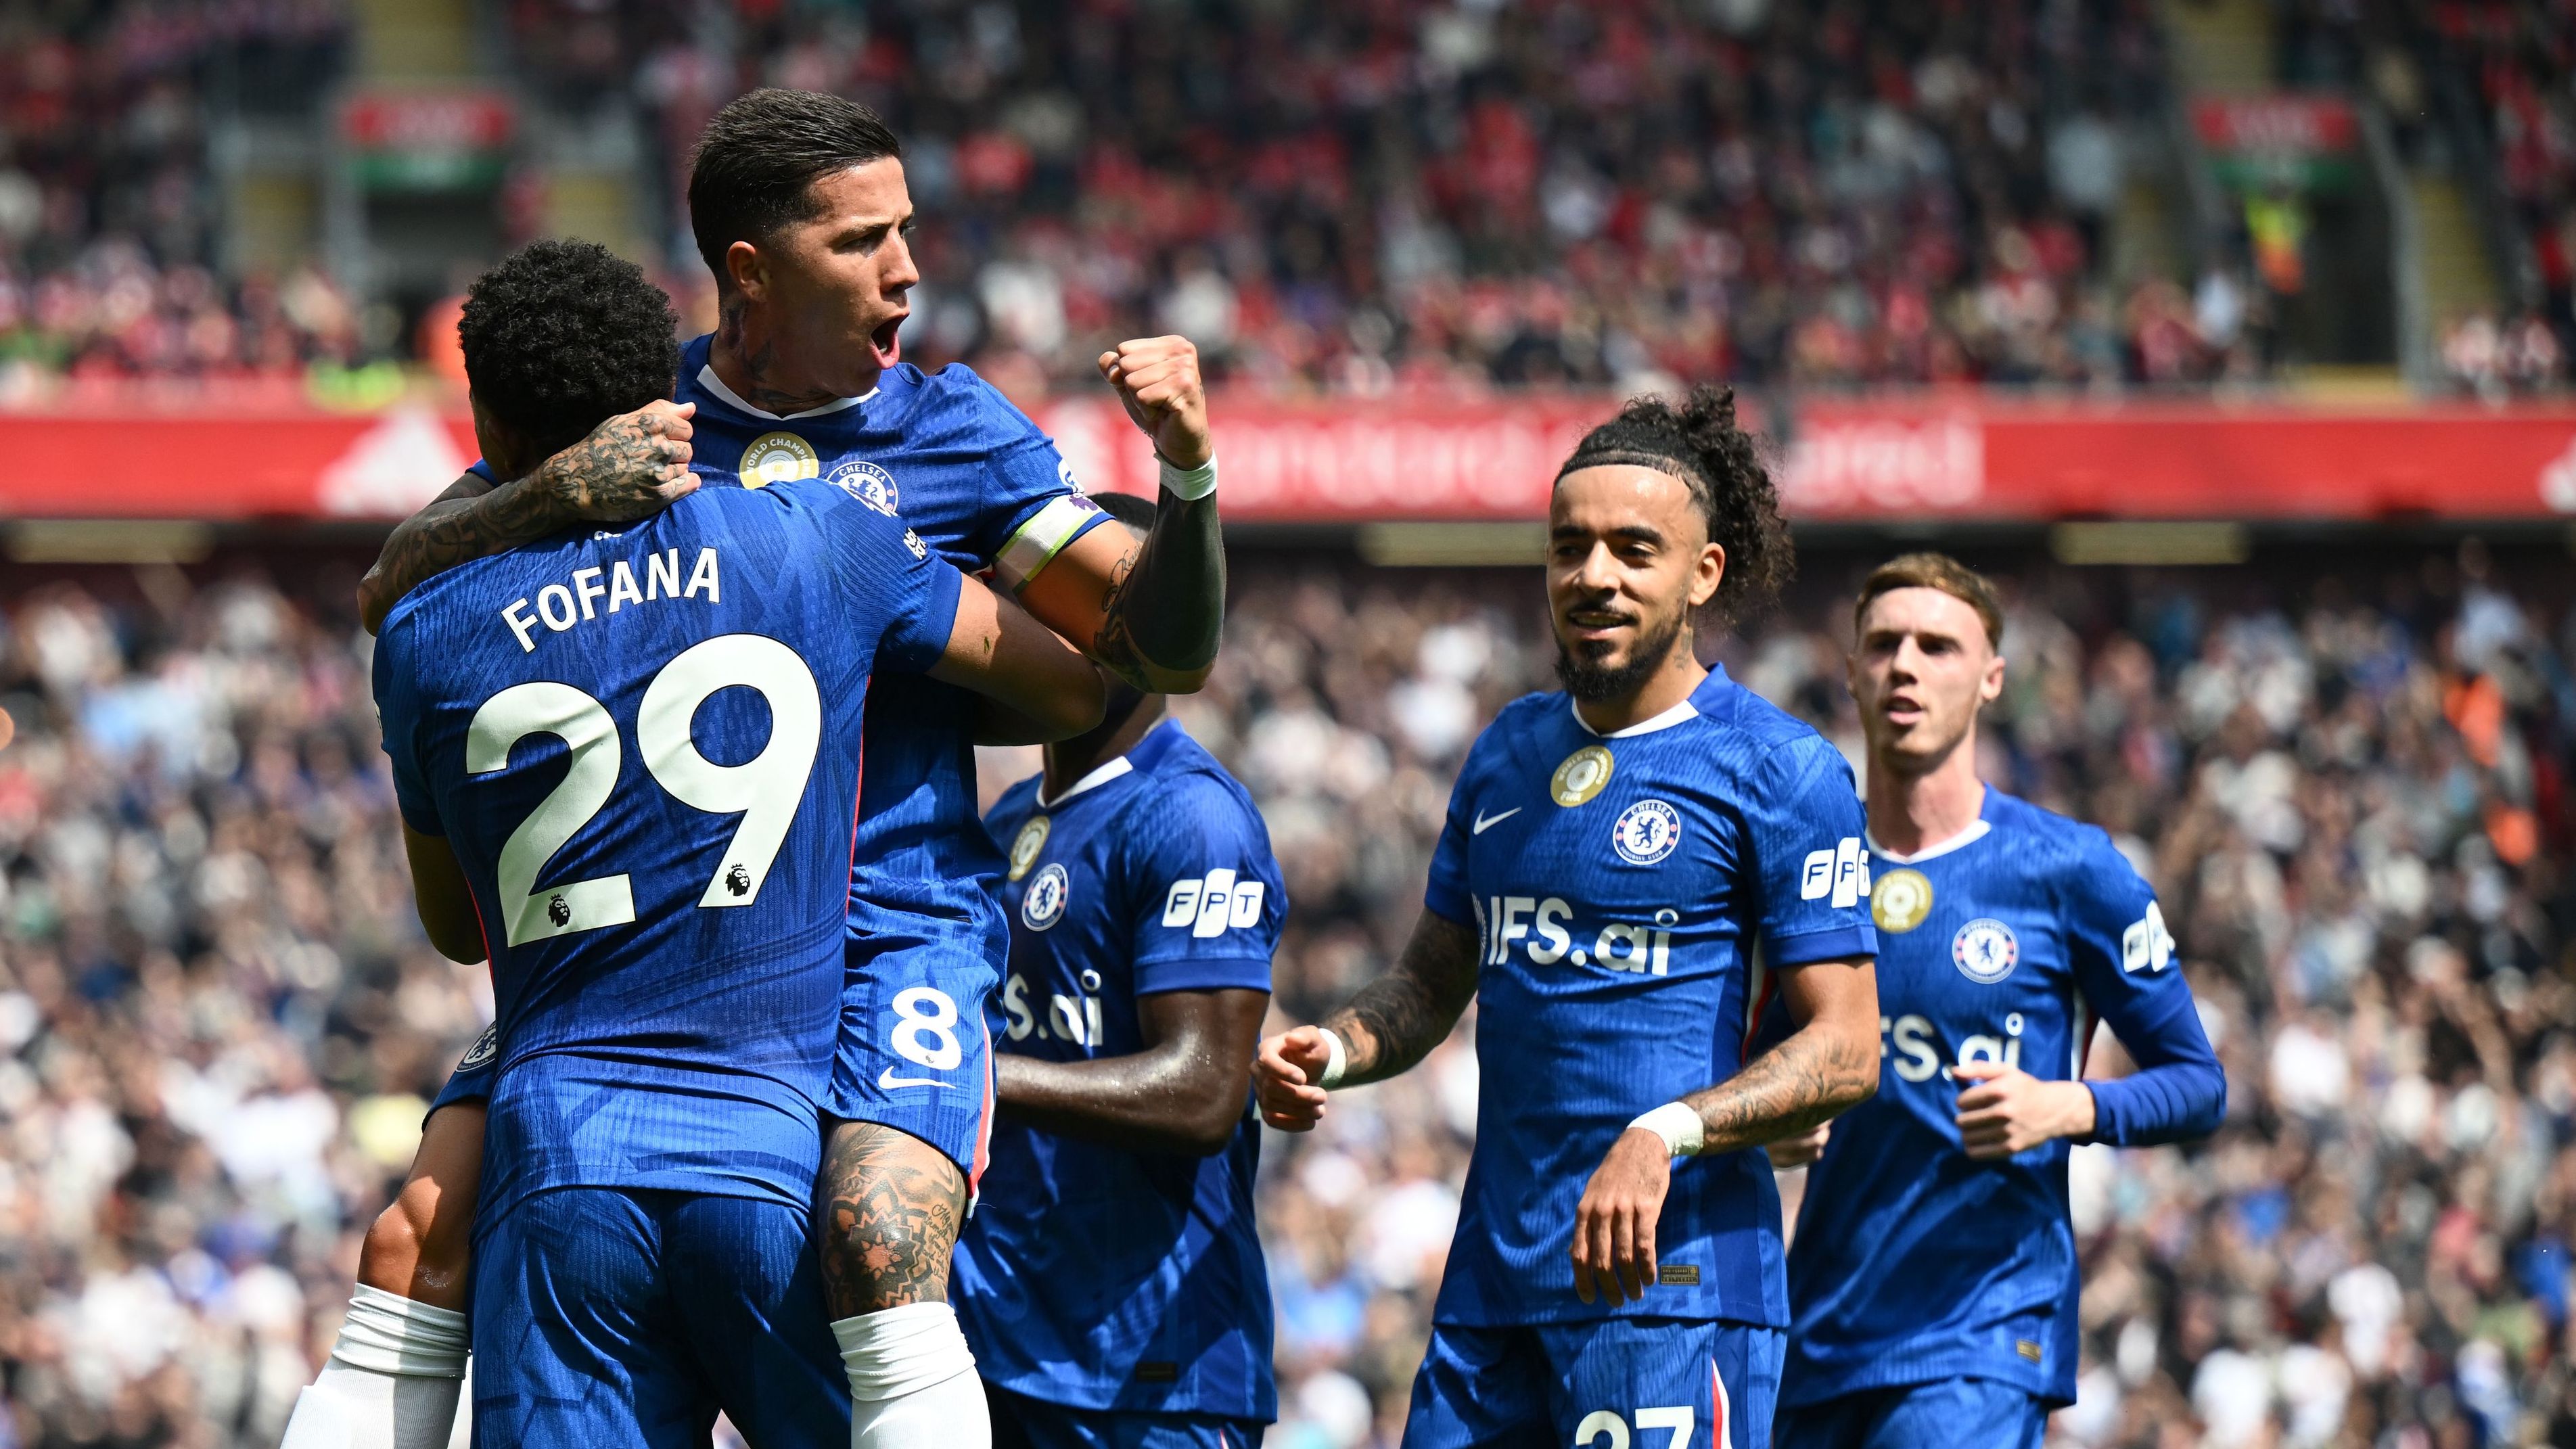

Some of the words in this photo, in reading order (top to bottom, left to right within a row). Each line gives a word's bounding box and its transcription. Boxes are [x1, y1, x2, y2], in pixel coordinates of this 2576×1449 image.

[839, 464, 887, 482] CHELSEA
[501, 547, 720, 653] FOFANA
[466, 633, 822, 948] 29
[1488, 895, 1680, 977] IFS.ai
[891, 987, 962, 1070] 8
[1004, 968, 1103, 1047] S.ai
[1880, 1012, 2024, 1082] S.ai
